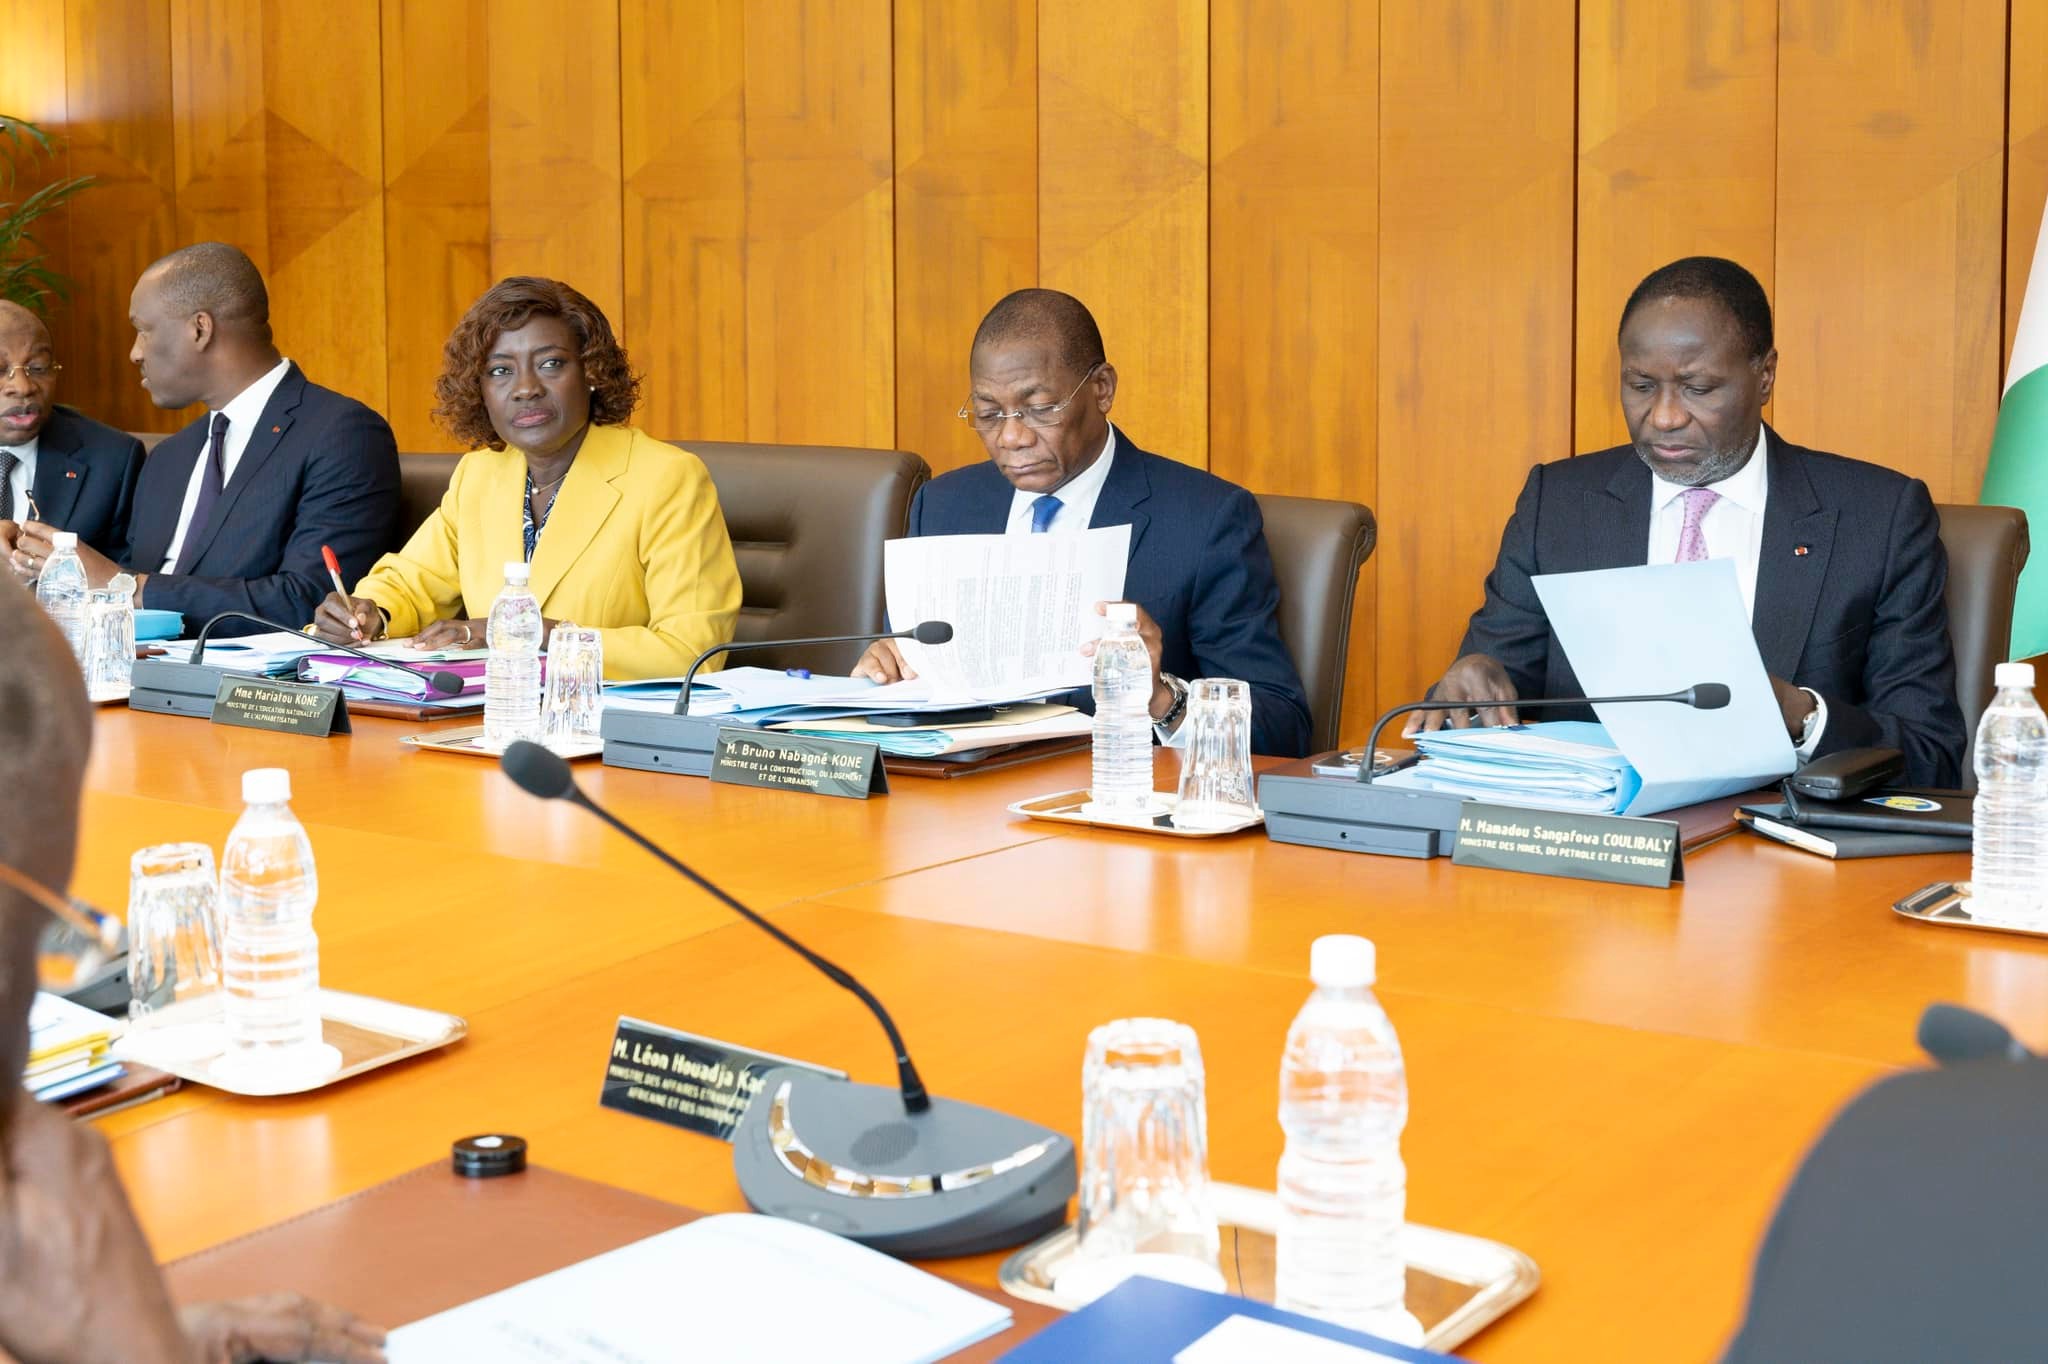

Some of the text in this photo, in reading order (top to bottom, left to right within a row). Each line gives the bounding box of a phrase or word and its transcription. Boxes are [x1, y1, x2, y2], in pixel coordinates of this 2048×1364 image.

[235, 688, 318, 706] Mme Mariatou KONE
[726, 743, 863, 768] M. Bruno Nabagné KONE
[720, 760, 748, 768] MINISTRE
[770, 765, 817, 778] CONSTRUCTION,
[830, 771, 862, 782] LOGEMENT
[778, 775, 820, 787] L'URBANISME
[1460, 818, 1672, 853] M. Mamadou Sangafowa COULIBALY
[1460, 838, 1496, 849] MINISTRE
[1499, 841, 1515, 851] DES
[1546, 846, 1558, 856] DU
[1560, 848, 1595, 860] PETROLE
[1598, 852, 1608, 861] ET
[1611, 854, 1623, 862] DE
[613, 1038, 628, 1060] M.
[633, 1042, 670, 1070] Léon
[672, 1053, 734, 1088] Houadja
